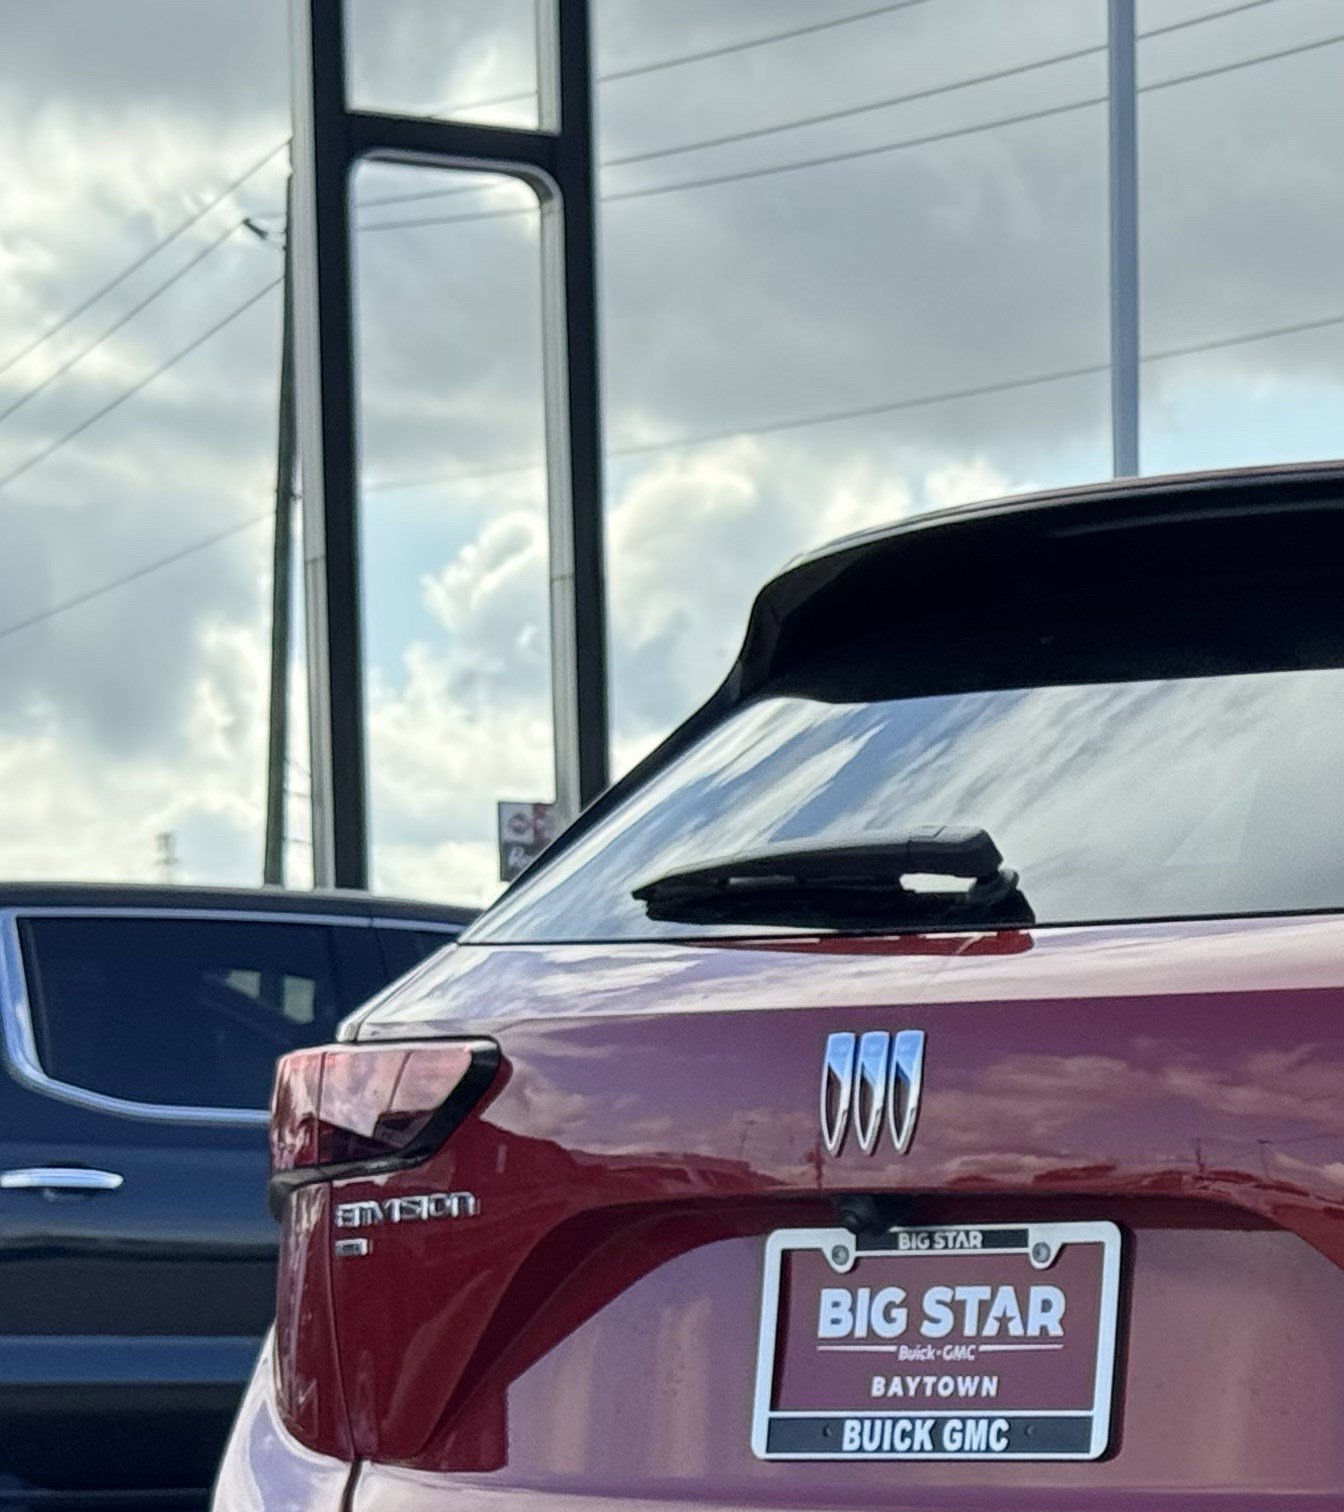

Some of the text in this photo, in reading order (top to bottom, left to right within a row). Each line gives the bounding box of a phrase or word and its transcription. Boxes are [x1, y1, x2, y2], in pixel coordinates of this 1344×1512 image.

[898, 1231, 983, 1250] BIG STAR
[817, 1284, 1067, 1338] BIG STAR
[871, 1375, 999, 1398] BAYTOWN
[841, 1416, 1011, 1452] BUICK GMC
